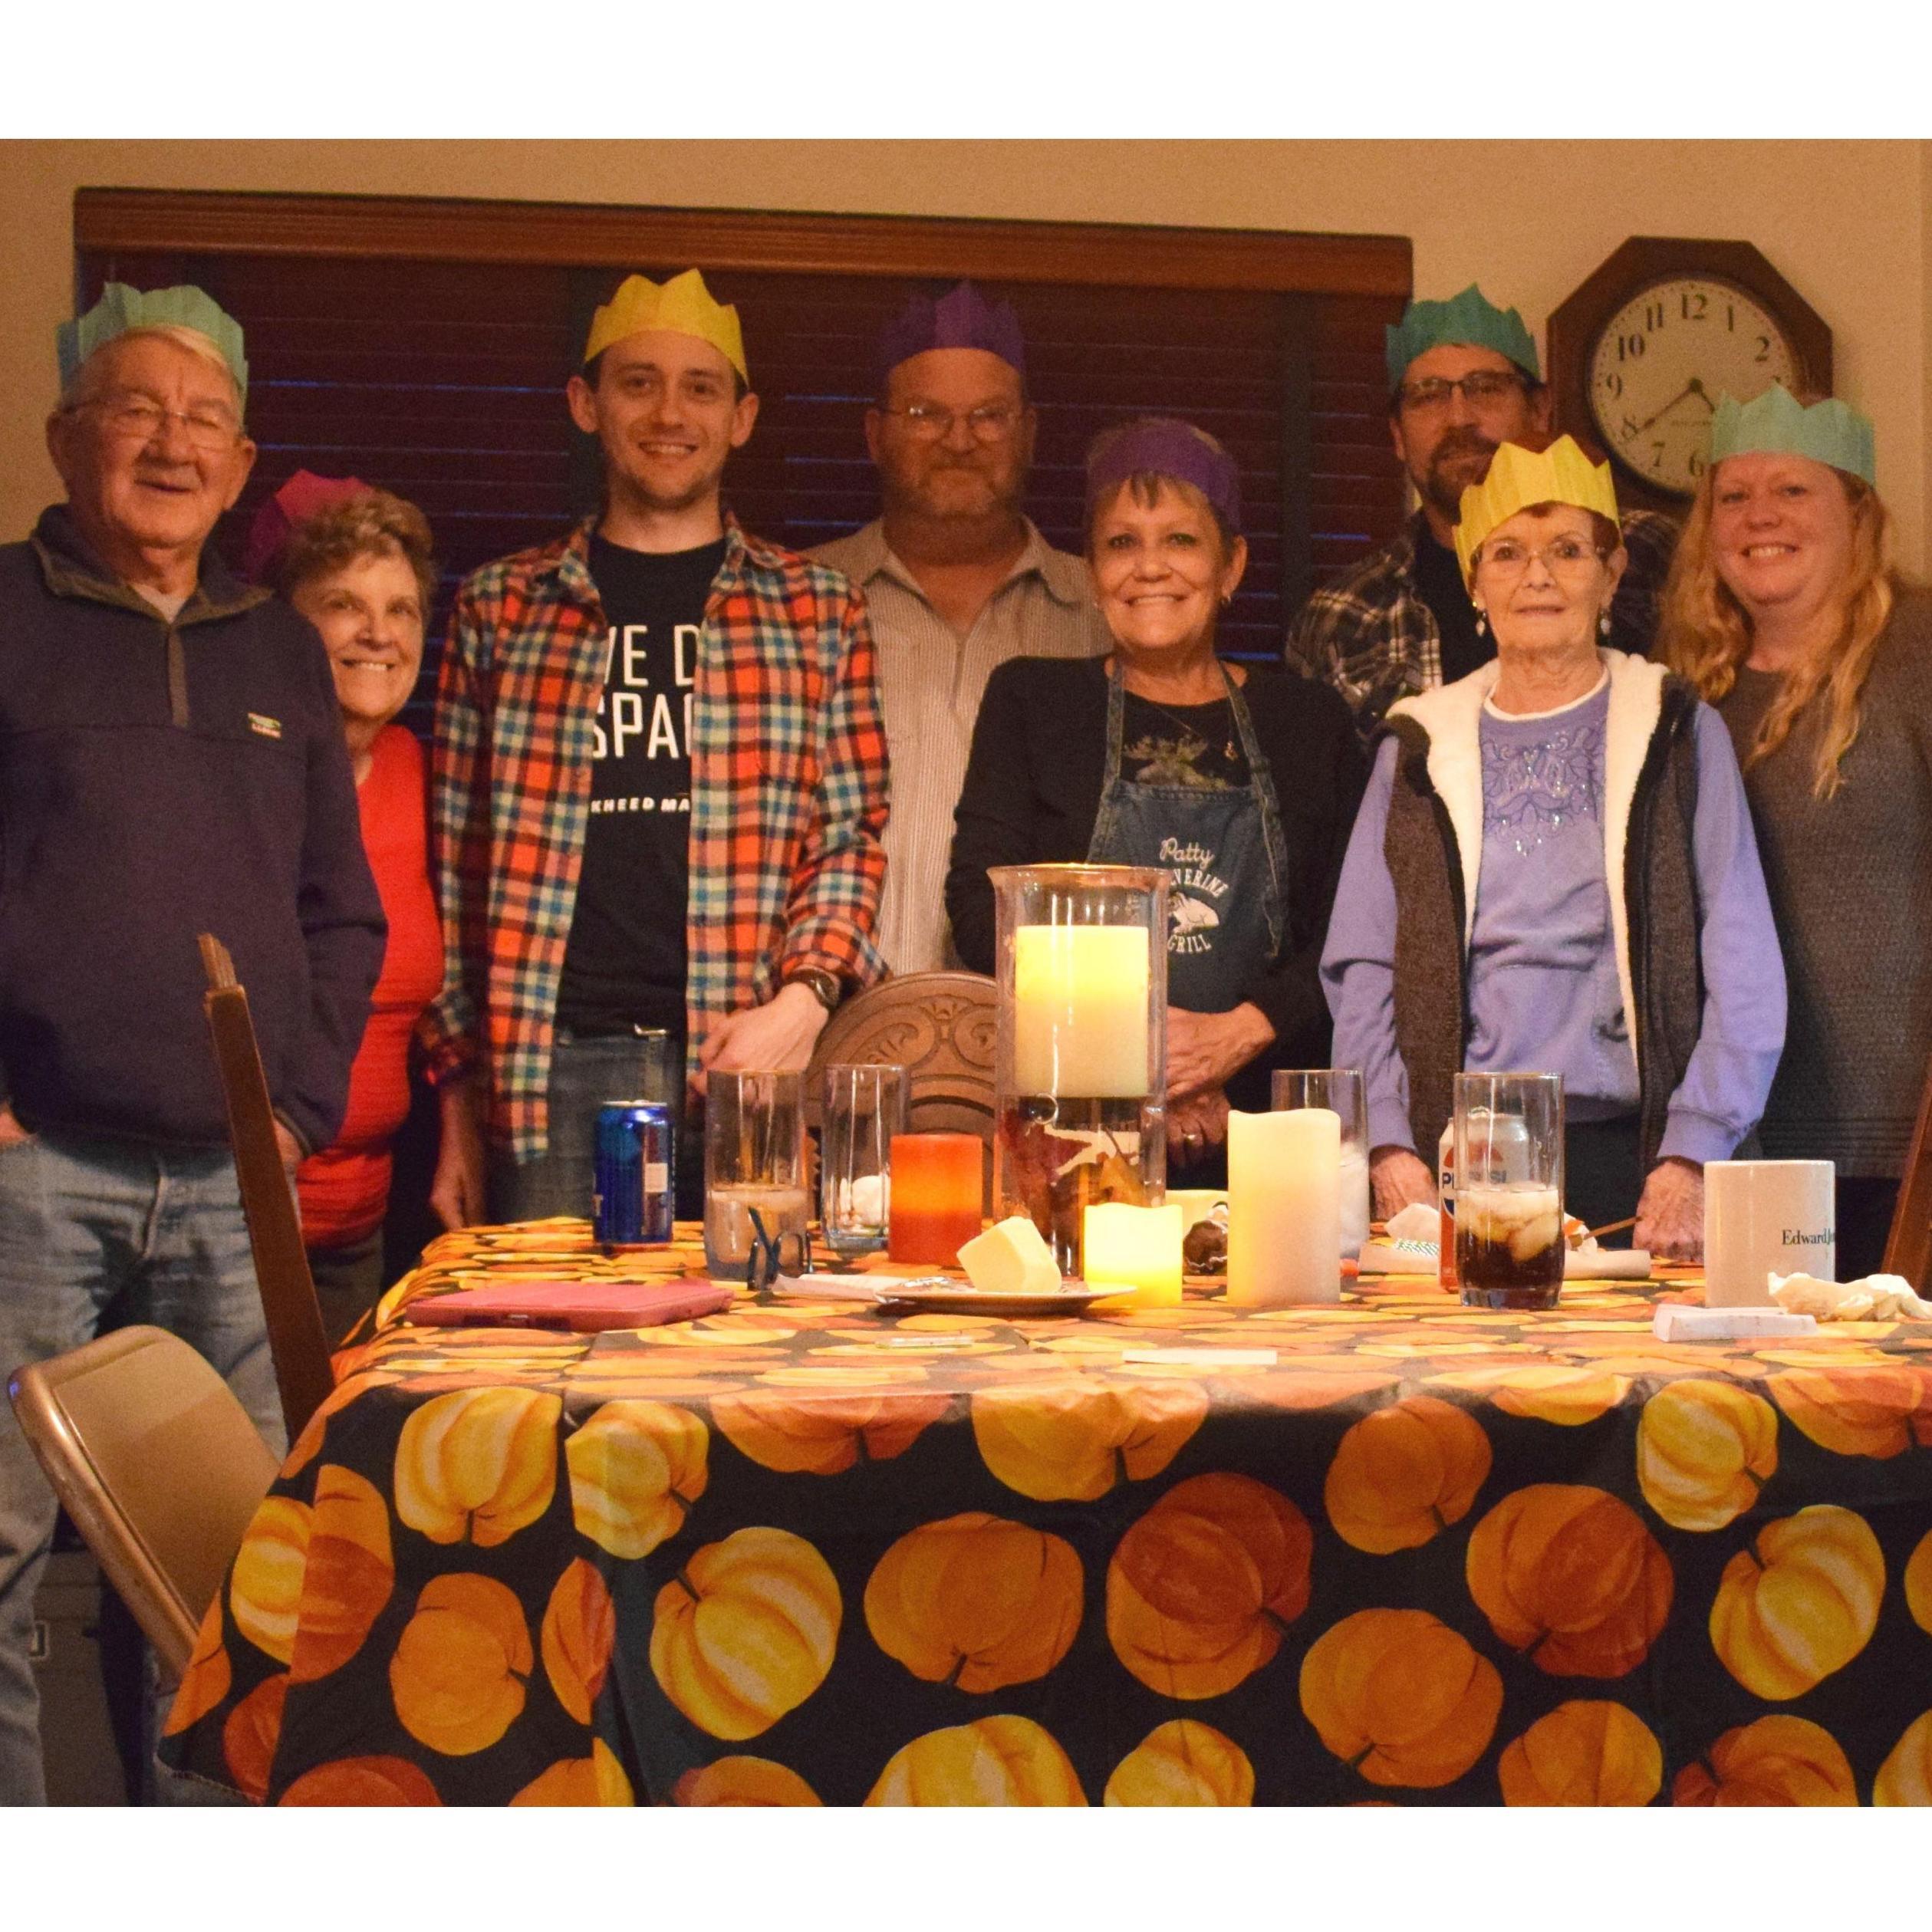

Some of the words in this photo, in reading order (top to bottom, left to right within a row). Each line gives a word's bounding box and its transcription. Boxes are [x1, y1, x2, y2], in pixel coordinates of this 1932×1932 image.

[1646, 302, 1664, 331] 11
[1681, 293, 1708, 321] 12
[1727, 304, 1734, 332] 1
[1618, 334, 1645, 361] 10
[1754, 336, 1771, 362] 2
[1606, 373, 1622, 400] 9
[1619, 416, 1639, 442] 8
[1651, 441, 1666, 467] 7
[1159, 837, 1216, 871] Patty
[1167, 933, 1212, 953] GRILL
